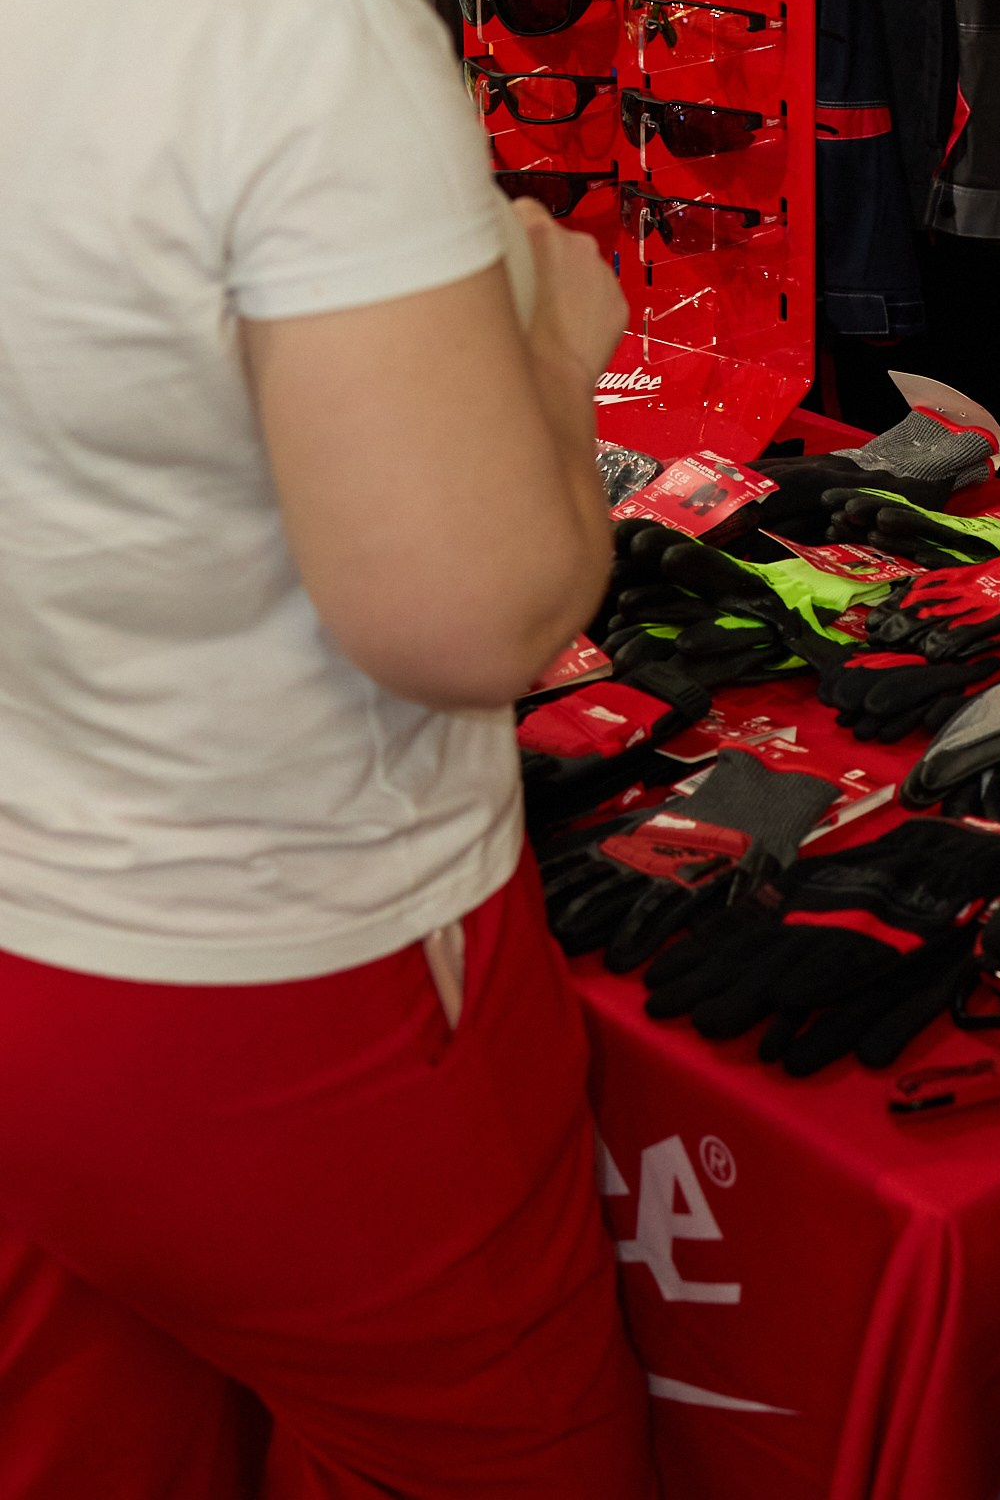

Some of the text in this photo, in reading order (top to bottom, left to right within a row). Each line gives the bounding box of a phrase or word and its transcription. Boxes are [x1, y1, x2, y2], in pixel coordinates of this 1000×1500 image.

[594, 366, 662, 390] aukee
[686, 457, 700, 467] CUT
[698, 463, 716, 476] LEVEL
